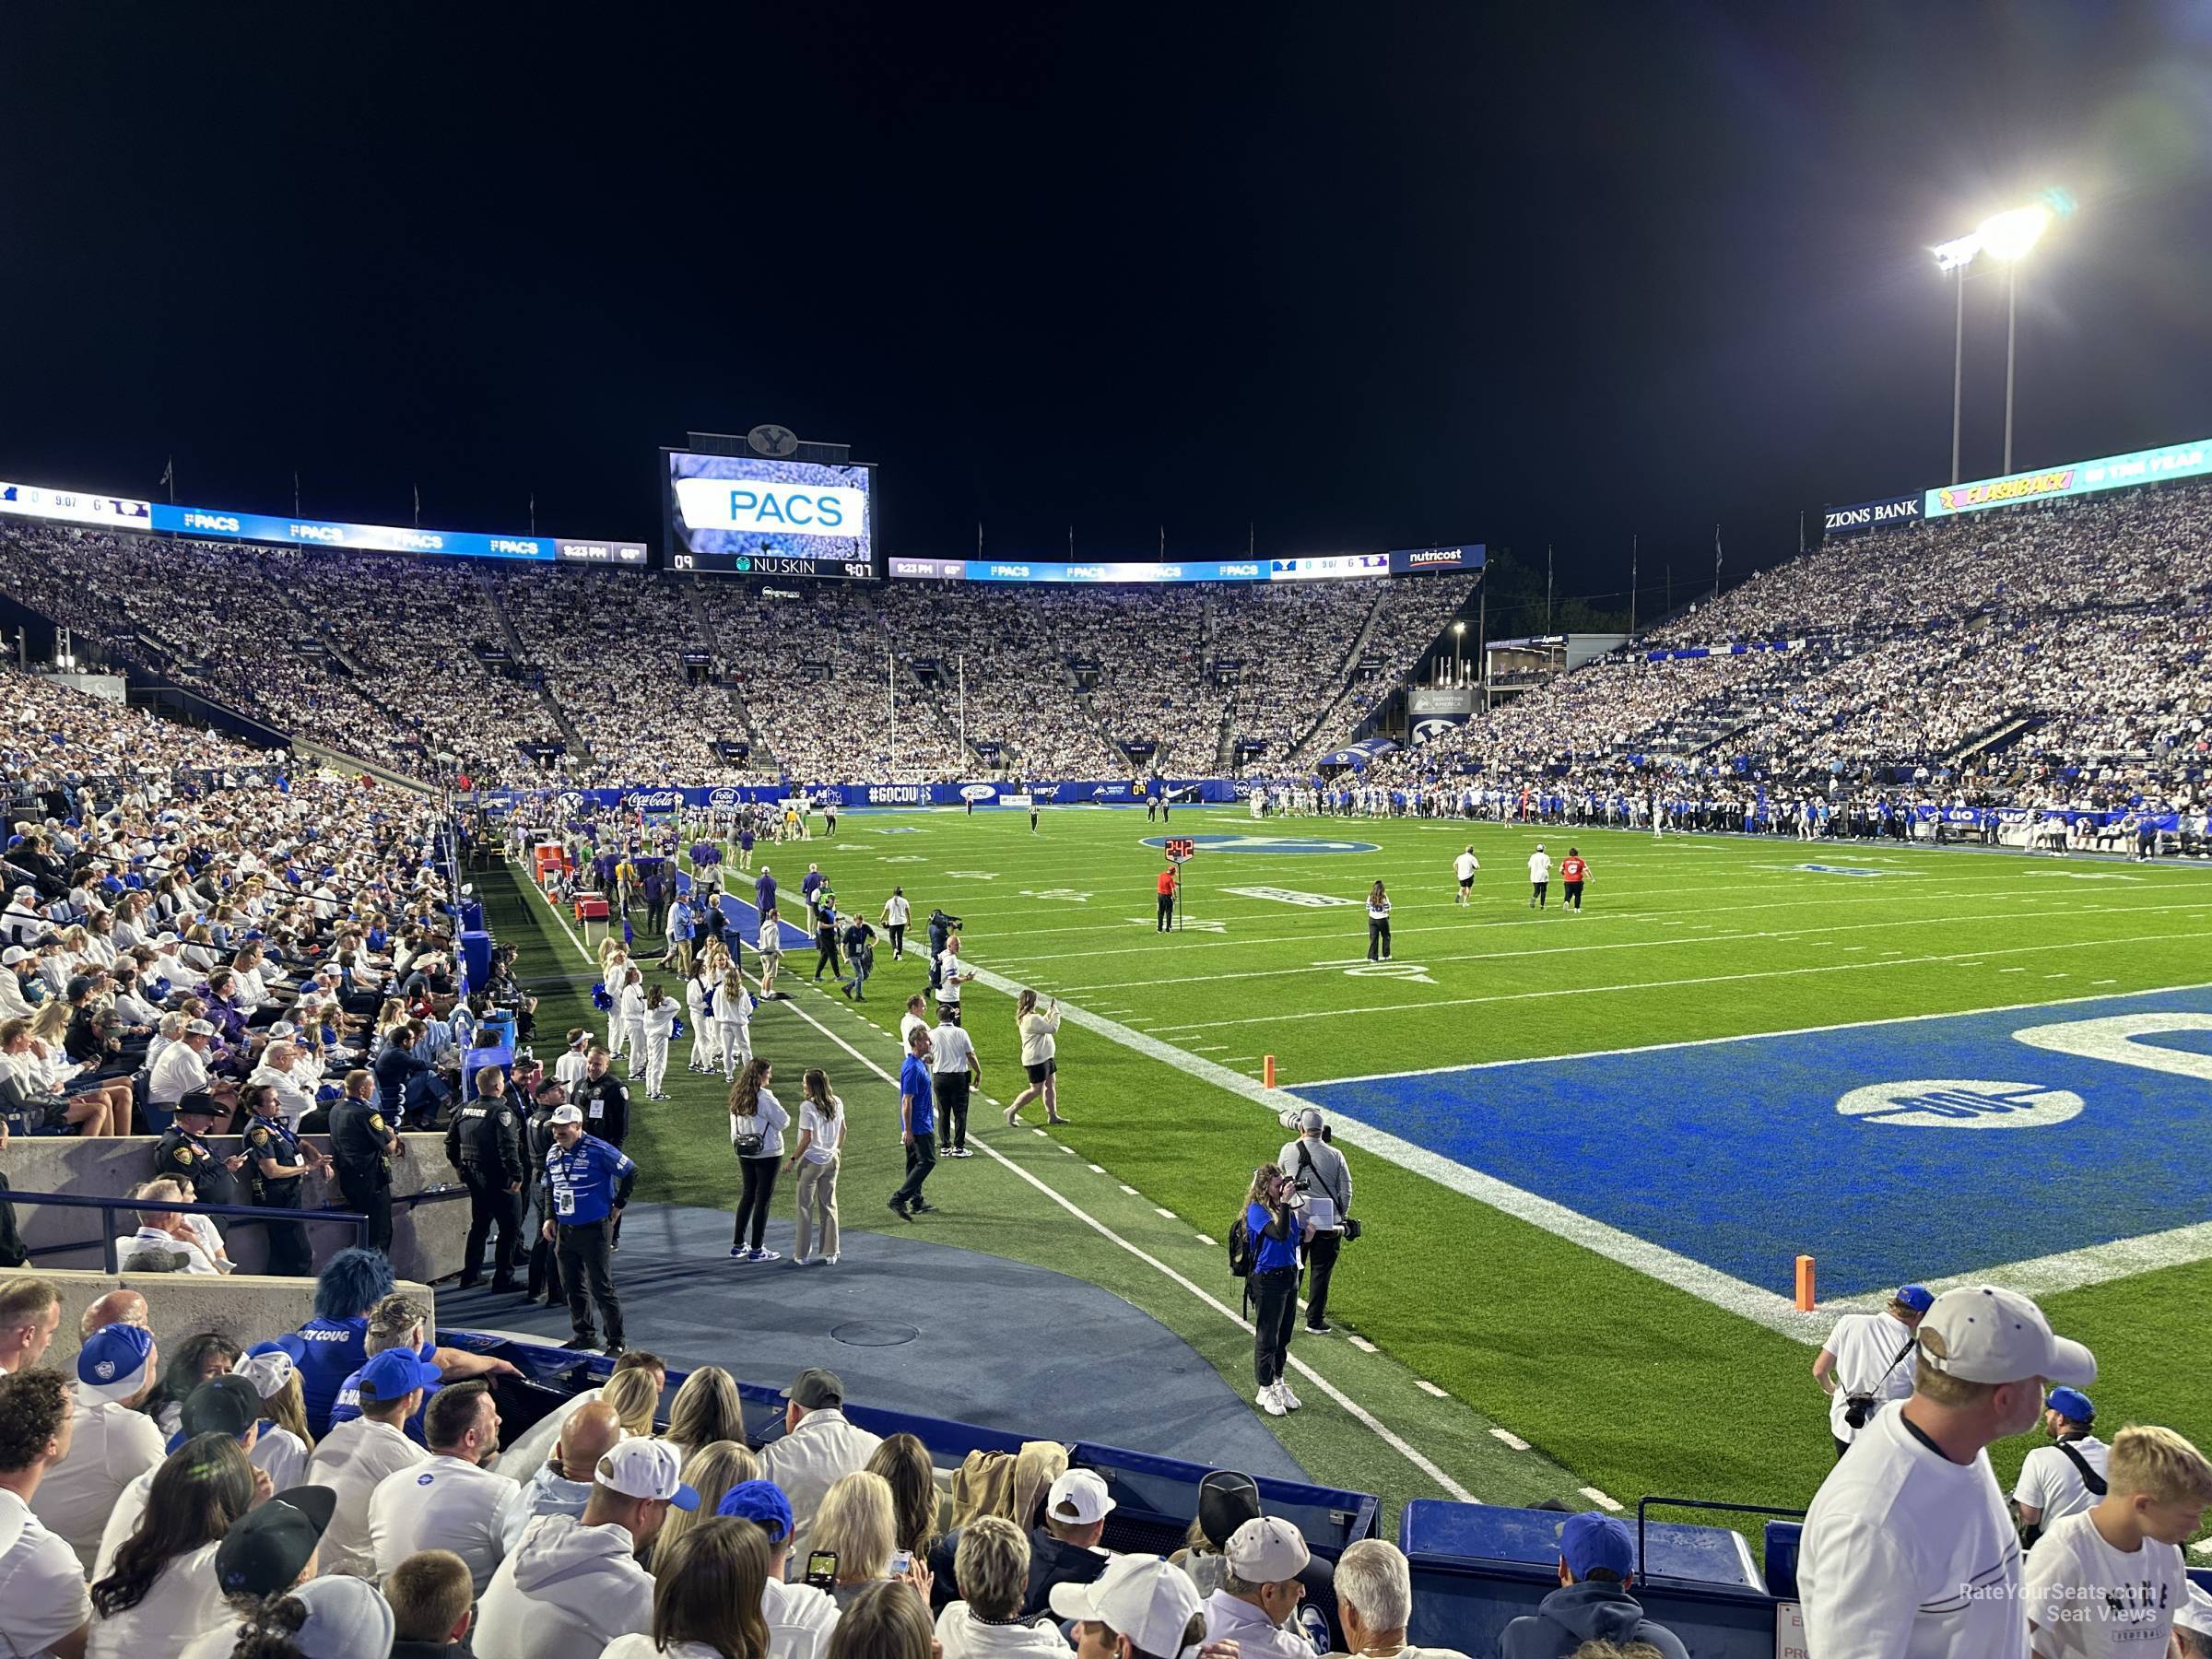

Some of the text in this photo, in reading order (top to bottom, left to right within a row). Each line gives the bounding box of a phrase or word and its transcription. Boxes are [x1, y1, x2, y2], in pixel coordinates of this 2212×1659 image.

[756, 428, 791, 453] Y
[1965, 471, 2068, 504] FLASHBACK
[729, 490, 842, 527] PACS
[1825, 500, 1919, 529] ZIONS BANK
[194, 514, 240, 533] PACS
[300, 524, 344, 542] PACS
[402, 534, 442, 549] PACS
[500, 540, 538, 555] PACS
[588, 547, 606, 559] PM
[1409, 547, 1462, 562] nutricost
[674, 554, 693, 569] 09
[754, 559, 815, 575] NU SKIN
[918, 564, 933, 573] PM
[844, 563, 872, 577] 9:07
[997, 566, 1030, 577] PACS
[1074, 567, 1106, 577] PACS
[1150, 566, 1182, 577] PACS
[1227, 564, 1259, 577] PACS
[715, 792, 734, 800] Food
[1133, 785, 1147, 795] 09
[628, 791, 675, 807] Coca-Cola
[1166, 840, 1193, 858] 2:42
[461, 1108, 487, 1117] POLICE
[316, 1330, 350, 1342] COUG
[337, 1389, 360, 1406] McMA
